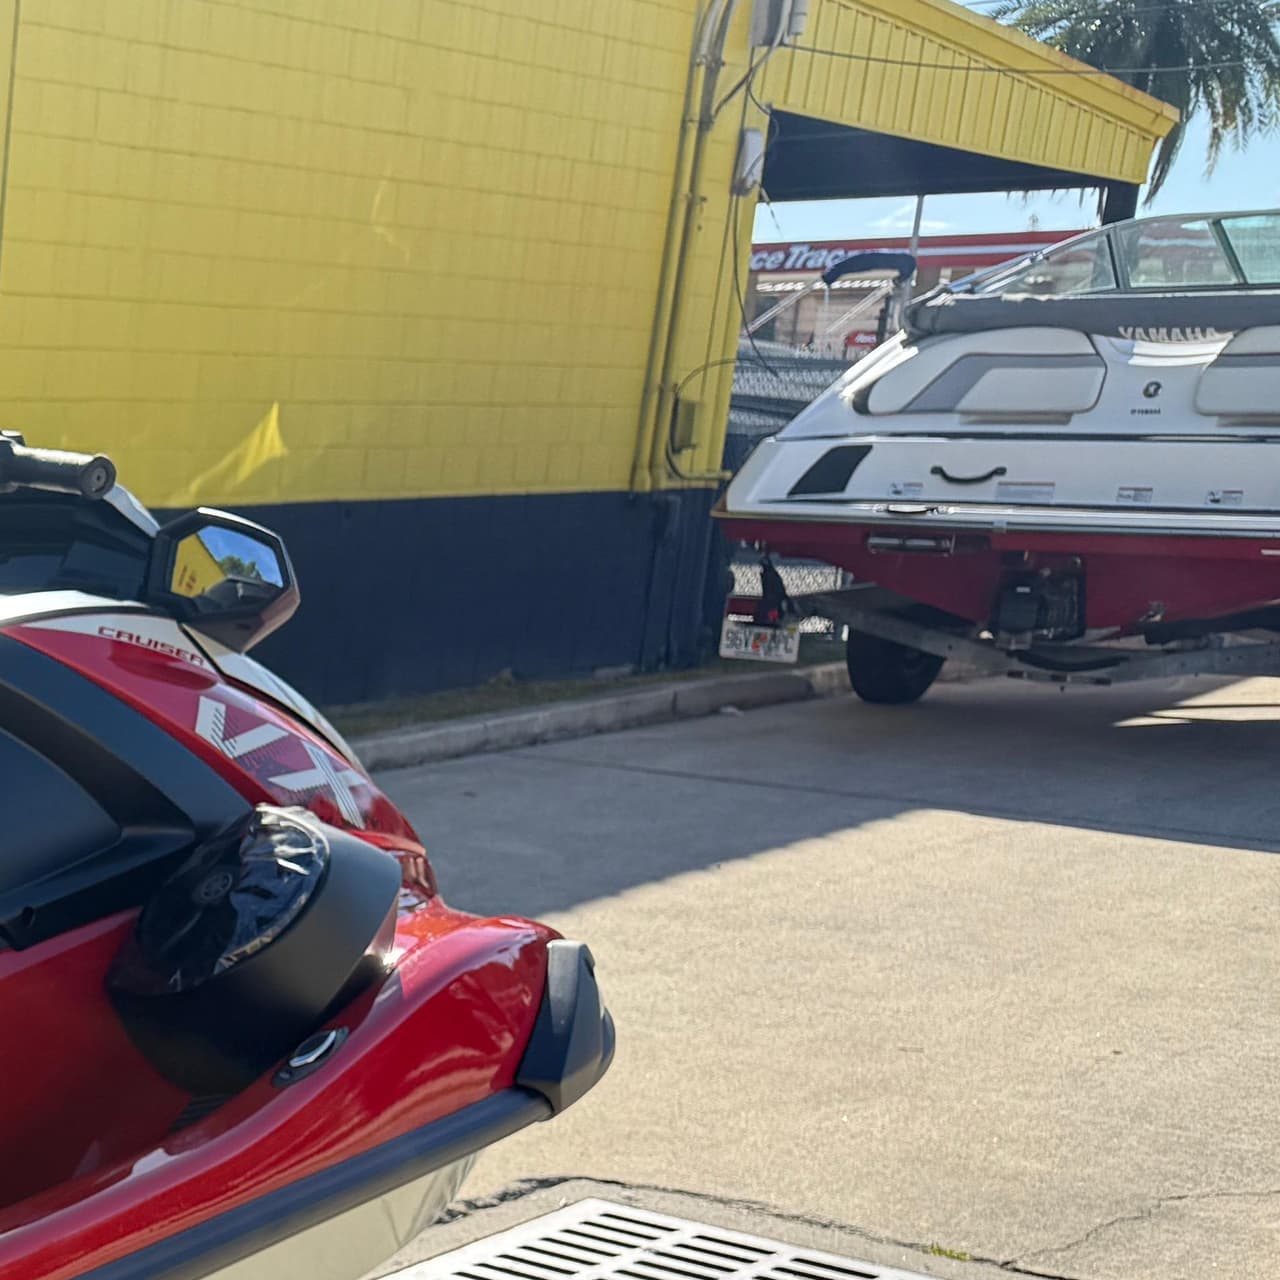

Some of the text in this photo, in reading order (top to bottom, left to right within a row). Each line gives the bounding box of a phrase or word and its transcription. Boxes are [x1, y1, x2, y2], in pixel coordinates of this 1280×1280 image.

[1118, 326, 1218, 343] YAMAHA
[98, 626, 204, 666] CRUISER
[195, 696, 369, 830] VX
